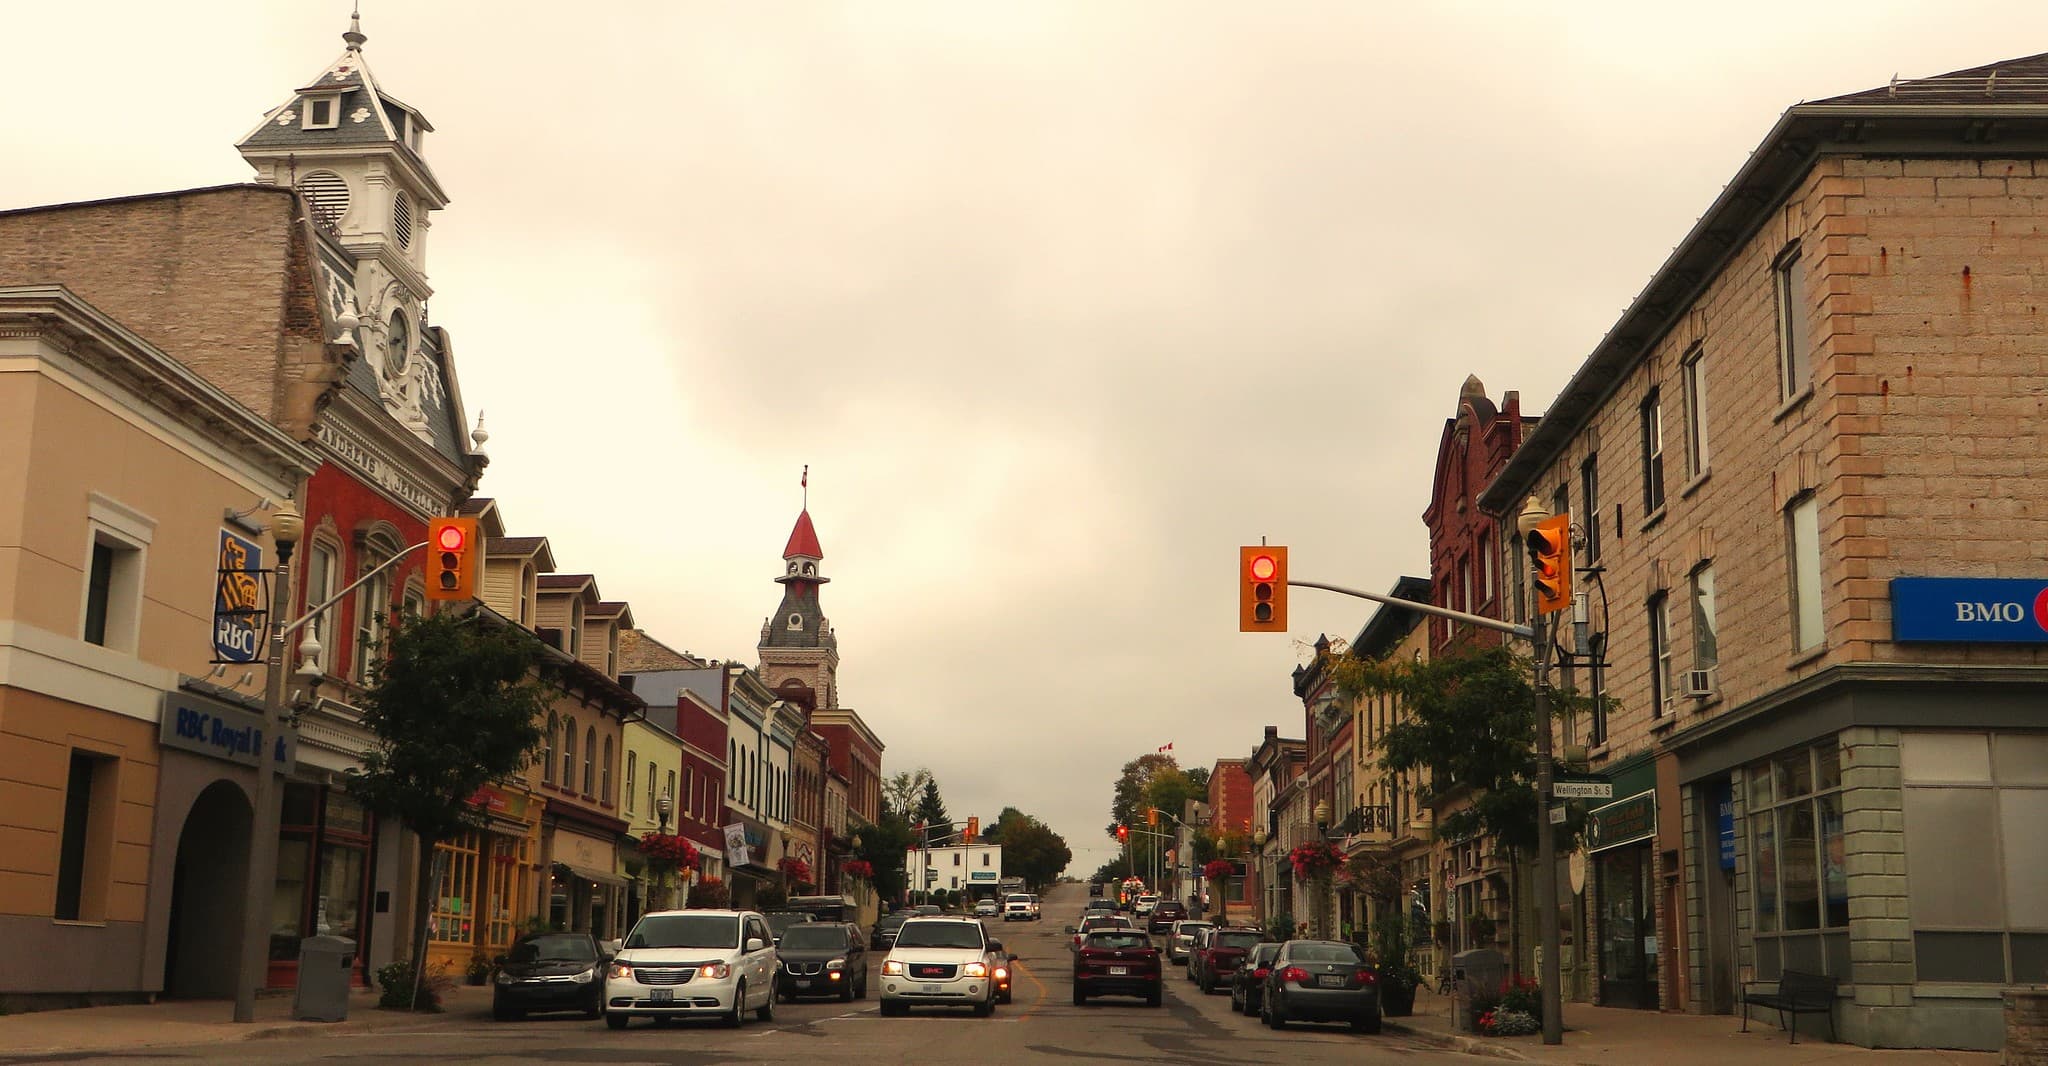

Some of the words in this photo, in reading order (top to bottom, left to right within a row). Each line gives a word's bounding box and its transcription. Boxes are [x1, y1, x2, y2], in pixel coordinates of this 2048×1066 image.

[321, 425, 376, 474] ANDREWS
[1954, 602, 2025, 623] BMO
[217, 618, 253, 654] RBC
[176, 707, 209, 742] RBC
[212, 718, 251, 756] Royal
[253, 730, 287, 762] Bk
[1555, 785, 1592, 797] Wellington
[1605, 786, 1610, 796] S
[921, 966, 945, 975] GMC
